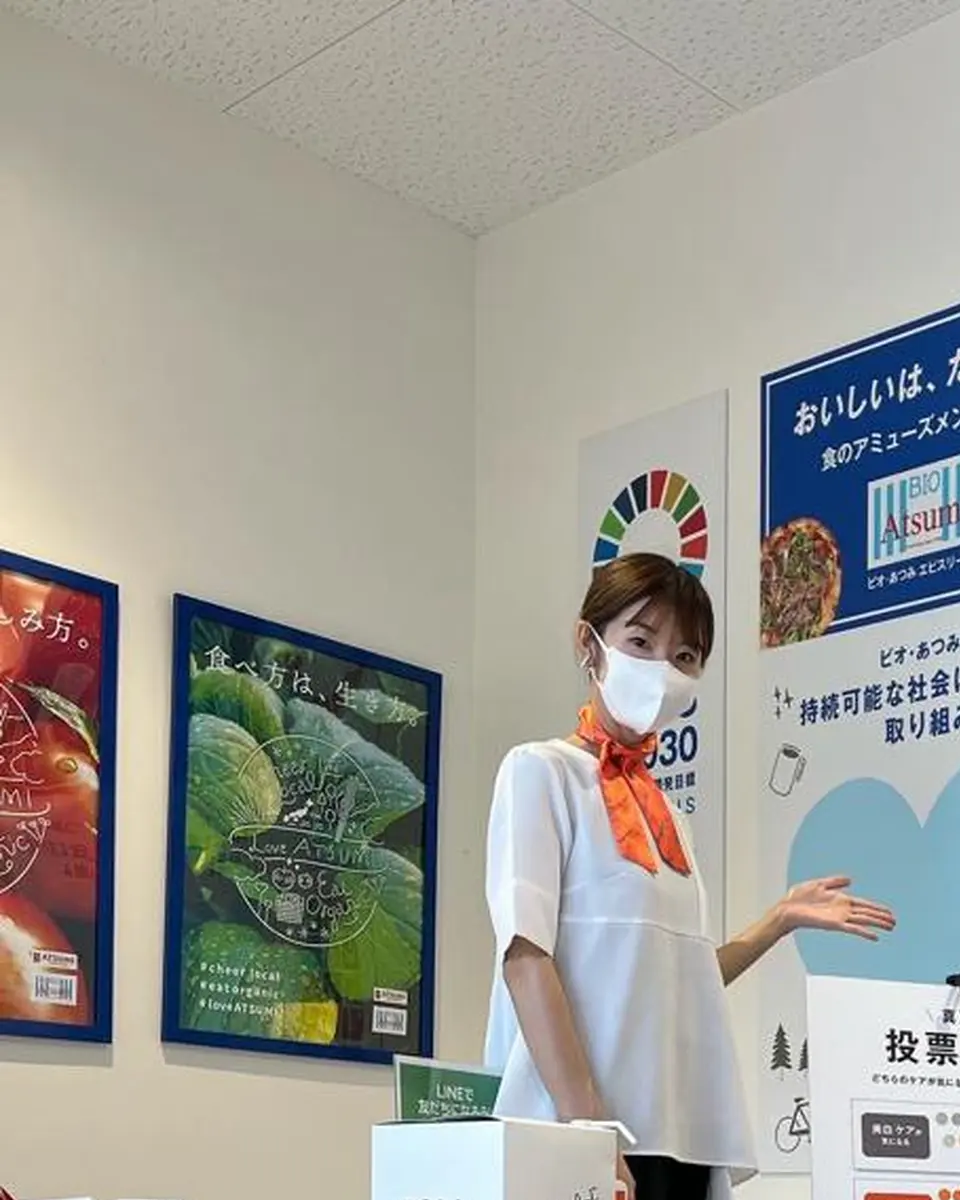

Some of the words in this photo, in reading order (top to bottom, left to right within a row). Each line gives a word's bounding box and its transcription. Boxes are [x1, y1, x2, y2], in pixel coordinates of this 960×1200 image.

[909, 469, 941, 499] BIO
[204, 645, 418, 728] 食べ方は、生き方。
